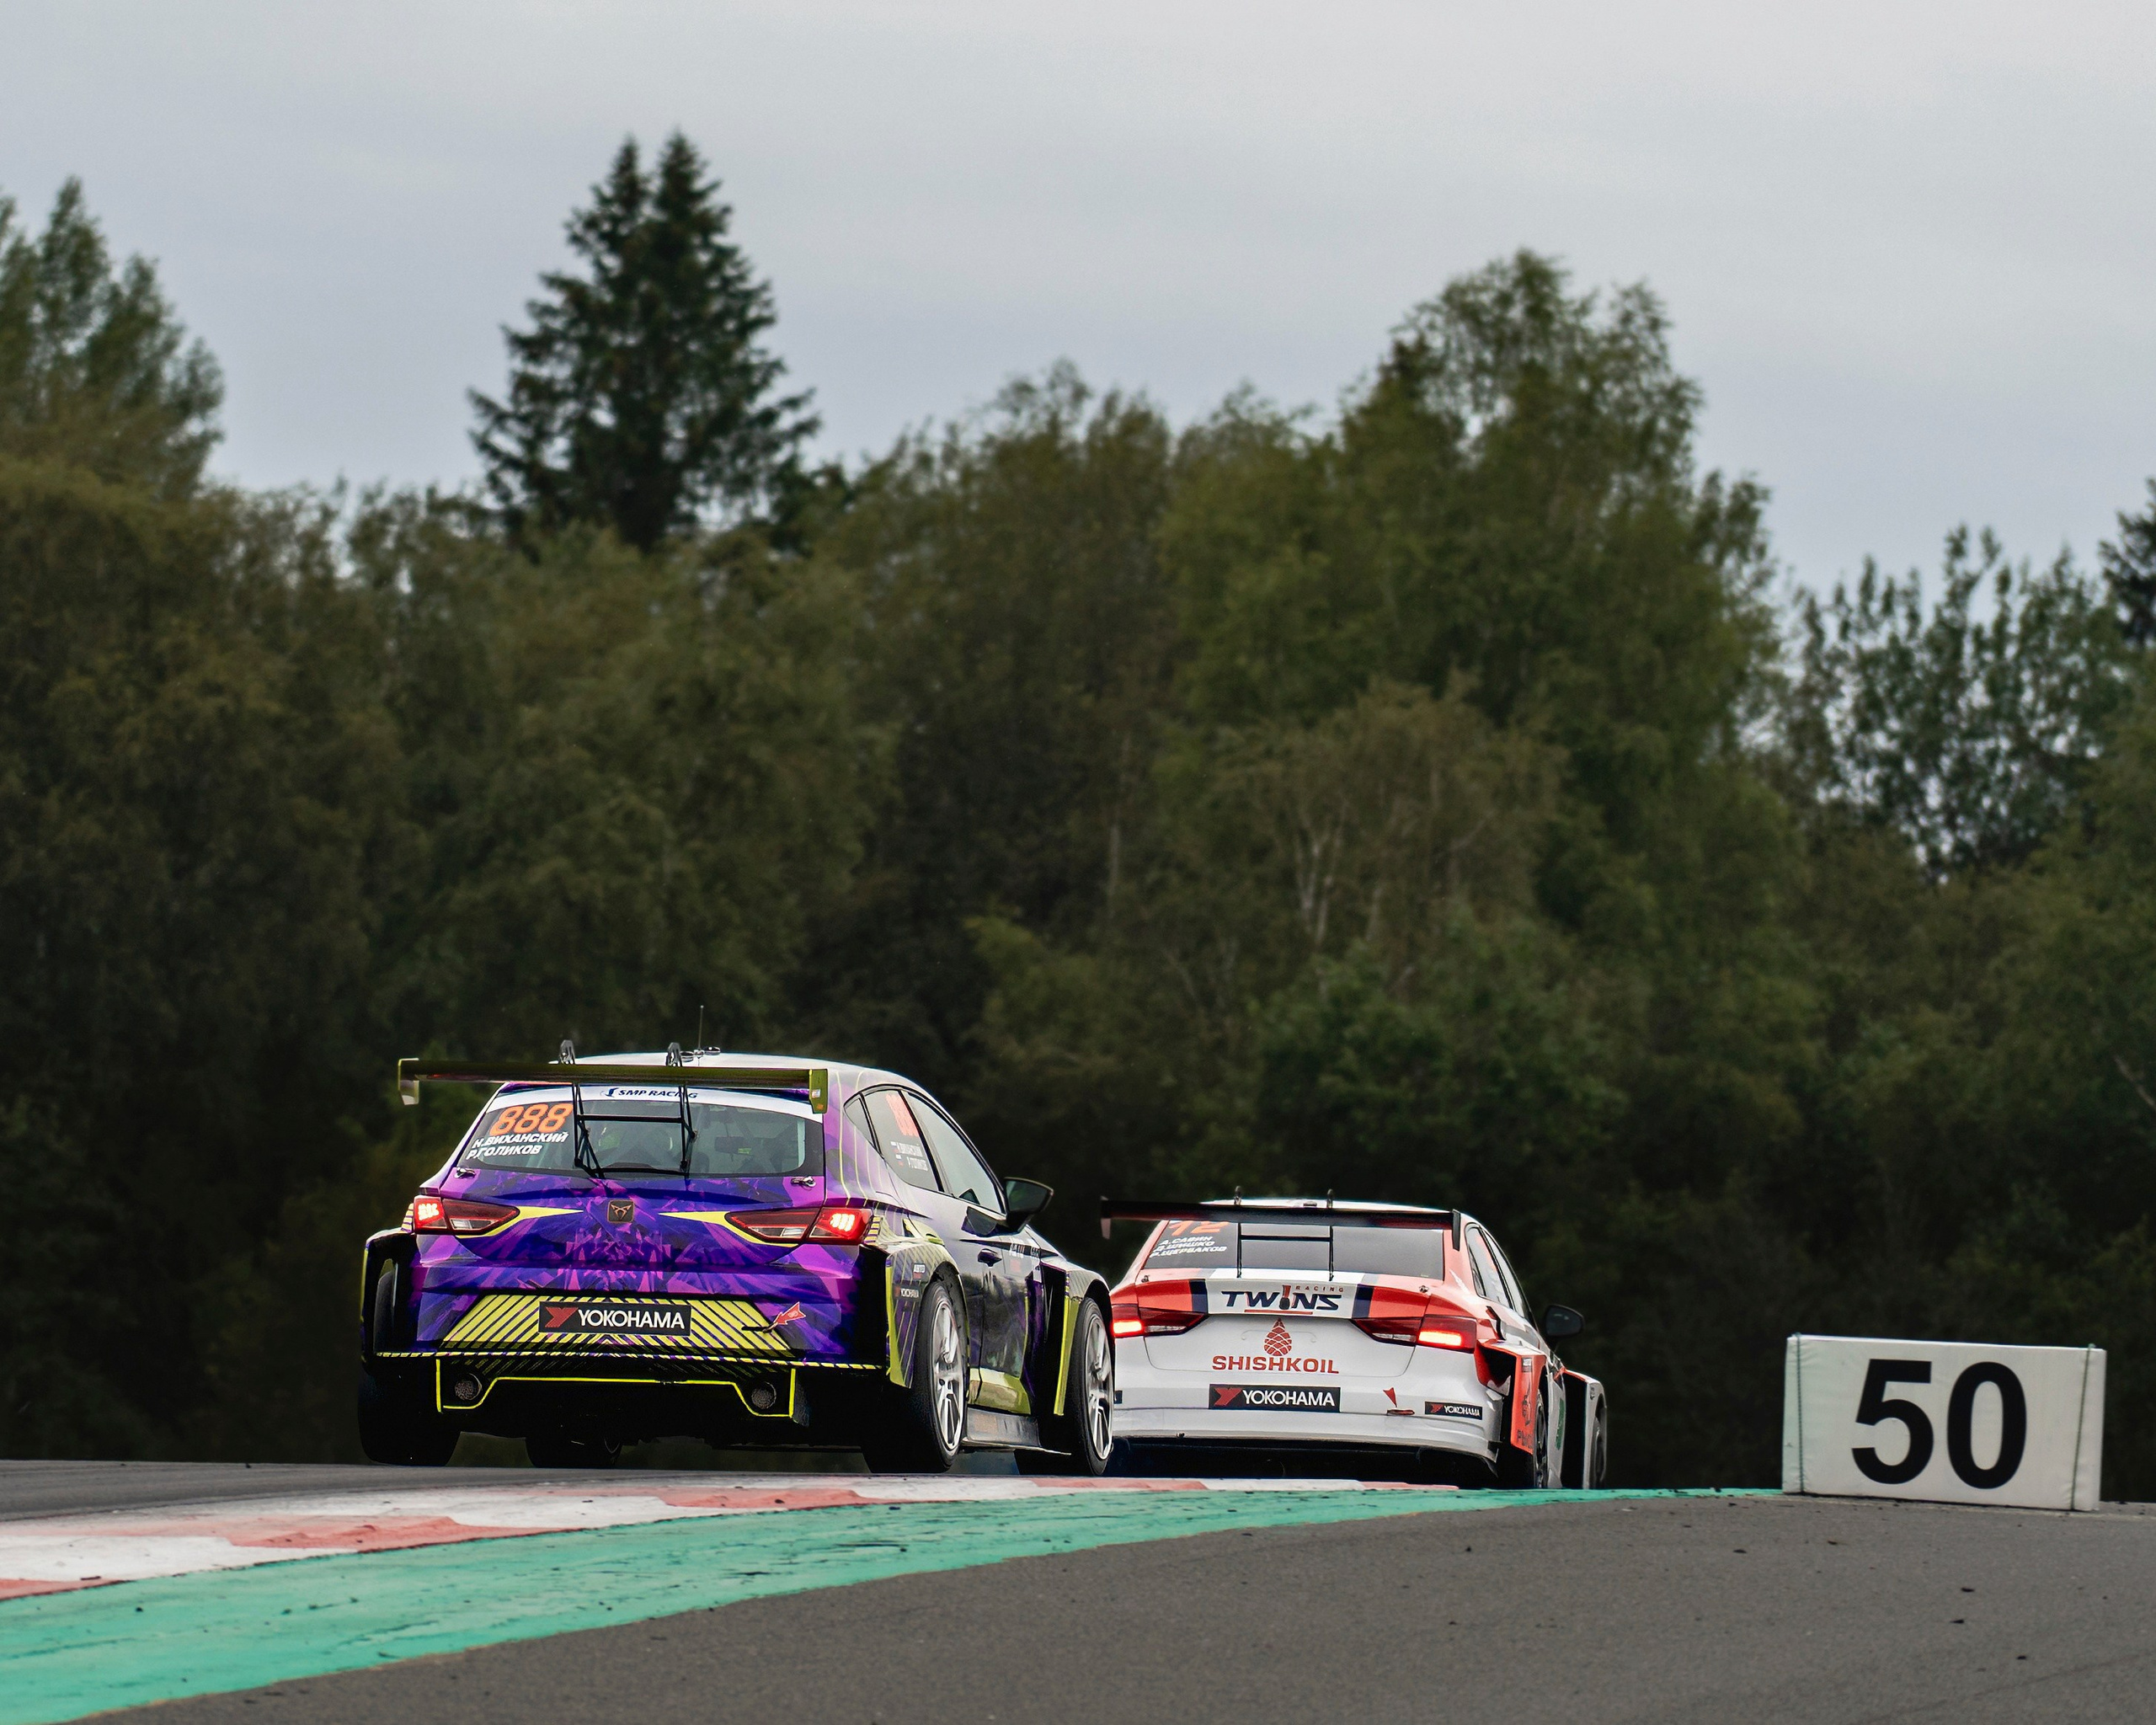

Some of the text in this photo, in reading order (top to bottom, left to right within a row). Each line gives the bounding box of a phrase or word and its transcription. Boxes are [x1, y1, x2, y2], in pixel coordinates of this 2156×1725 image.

[489, 1103, 574, 1136] 888
[578, 1309, 685, 1330] YOKOHAMA
[1212, 1355, 1340, 1375] SHISHKOIL
[1242, 1390, 1336, 1407] YOKOHAMA
[1851, 1359, 2028, 1489] 50
